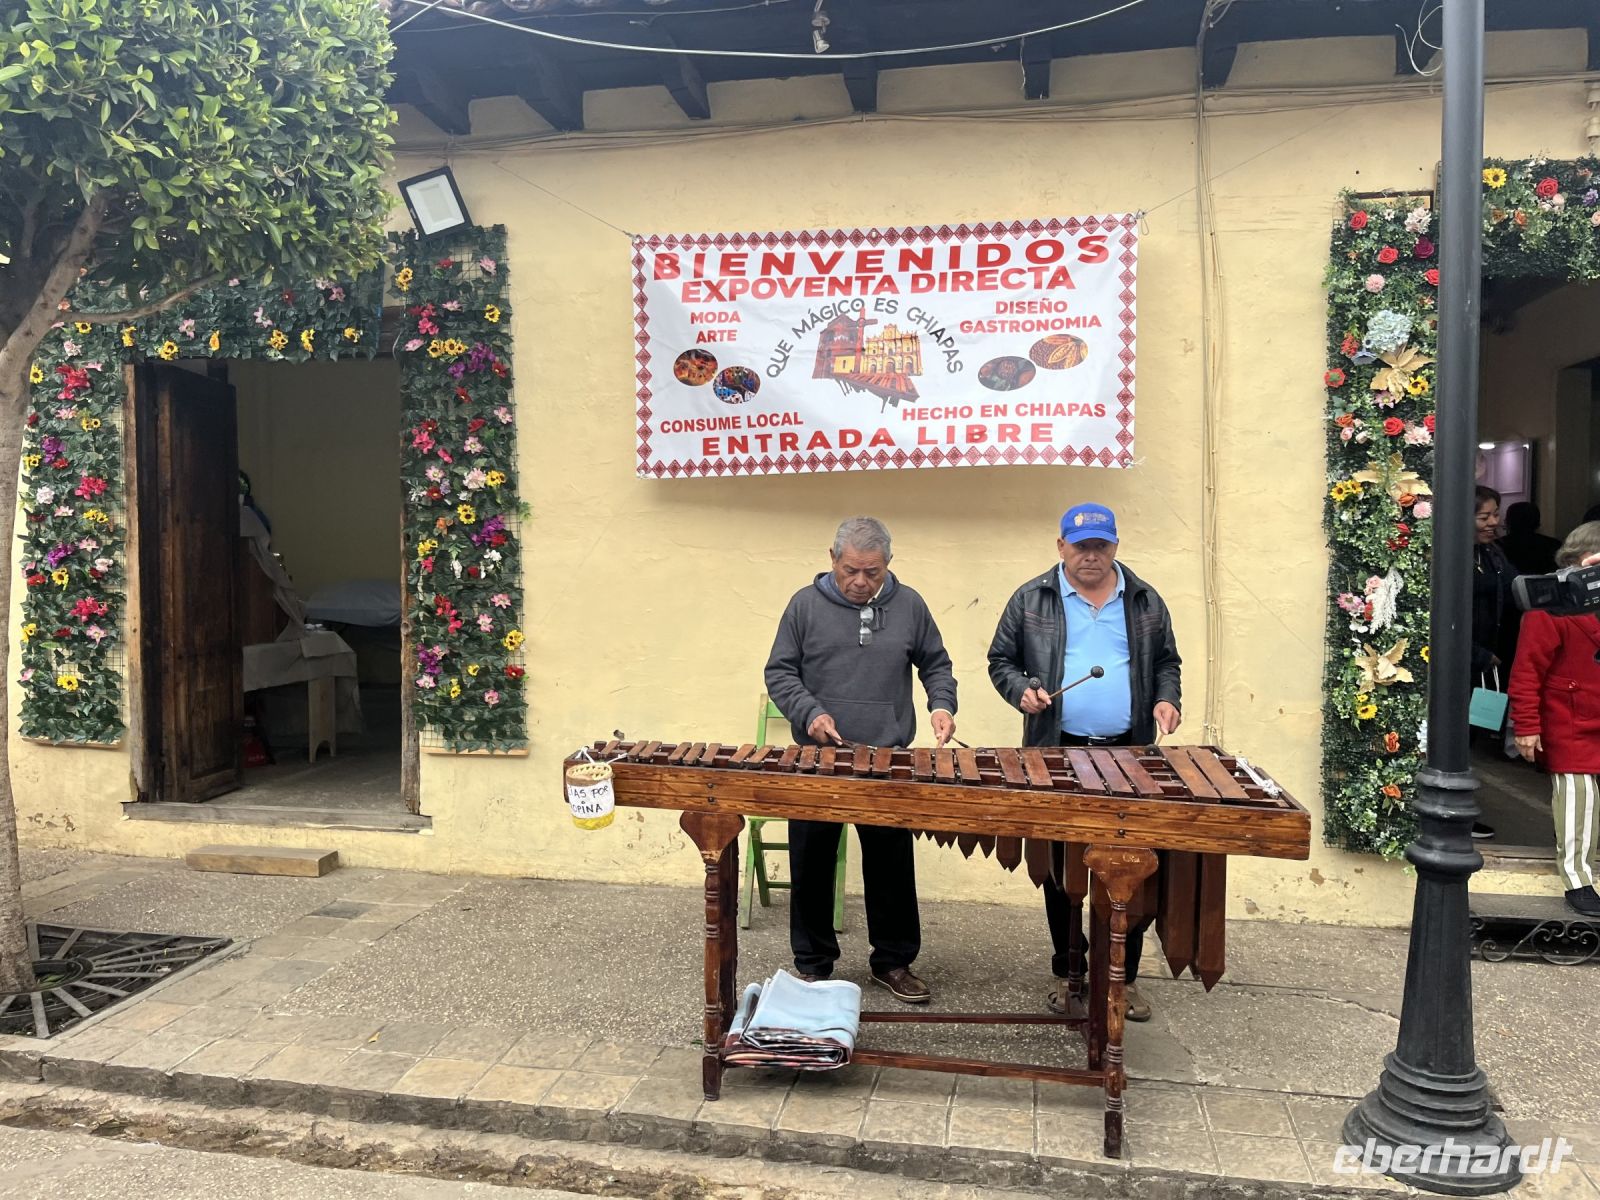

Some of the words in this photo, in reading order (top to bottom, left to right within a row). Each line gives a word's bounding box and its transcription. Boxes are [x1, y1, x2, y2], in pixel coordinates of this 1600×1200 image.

[654, 235, 1109, 280] BIENVENIDOS
[681, 275, 900, 303] EXPOVENTA
[910, 265, 1076, 294] DIRECTA
[995, 298, 1068, 315] DISEÑO
[690, 310, 741, 325] MODA
[959, 315, 1102, 334] GASTRONOMIA
[695, 329, 737, 344] ARTE
[766, 340, 794, 379] QUE
[792, 297, 865, 340] MÁGICO
[873, 298, 899, 314] ES
[906, 306, 964, 374] CHIAPAS
[902, 405, 973, 421] HECHO
[980, 403, 1008, 417] EN
[1015, 403, 1106, 417] CHIAPAS
[660, 415, 741, 433] CONSUME
[746, 412, 804, 429] LOCAL
[702, 427, 896, 456] ENTRADA
[917, 423, 1053, 446] LIBRE
[591, 785, 608, 798] POR
